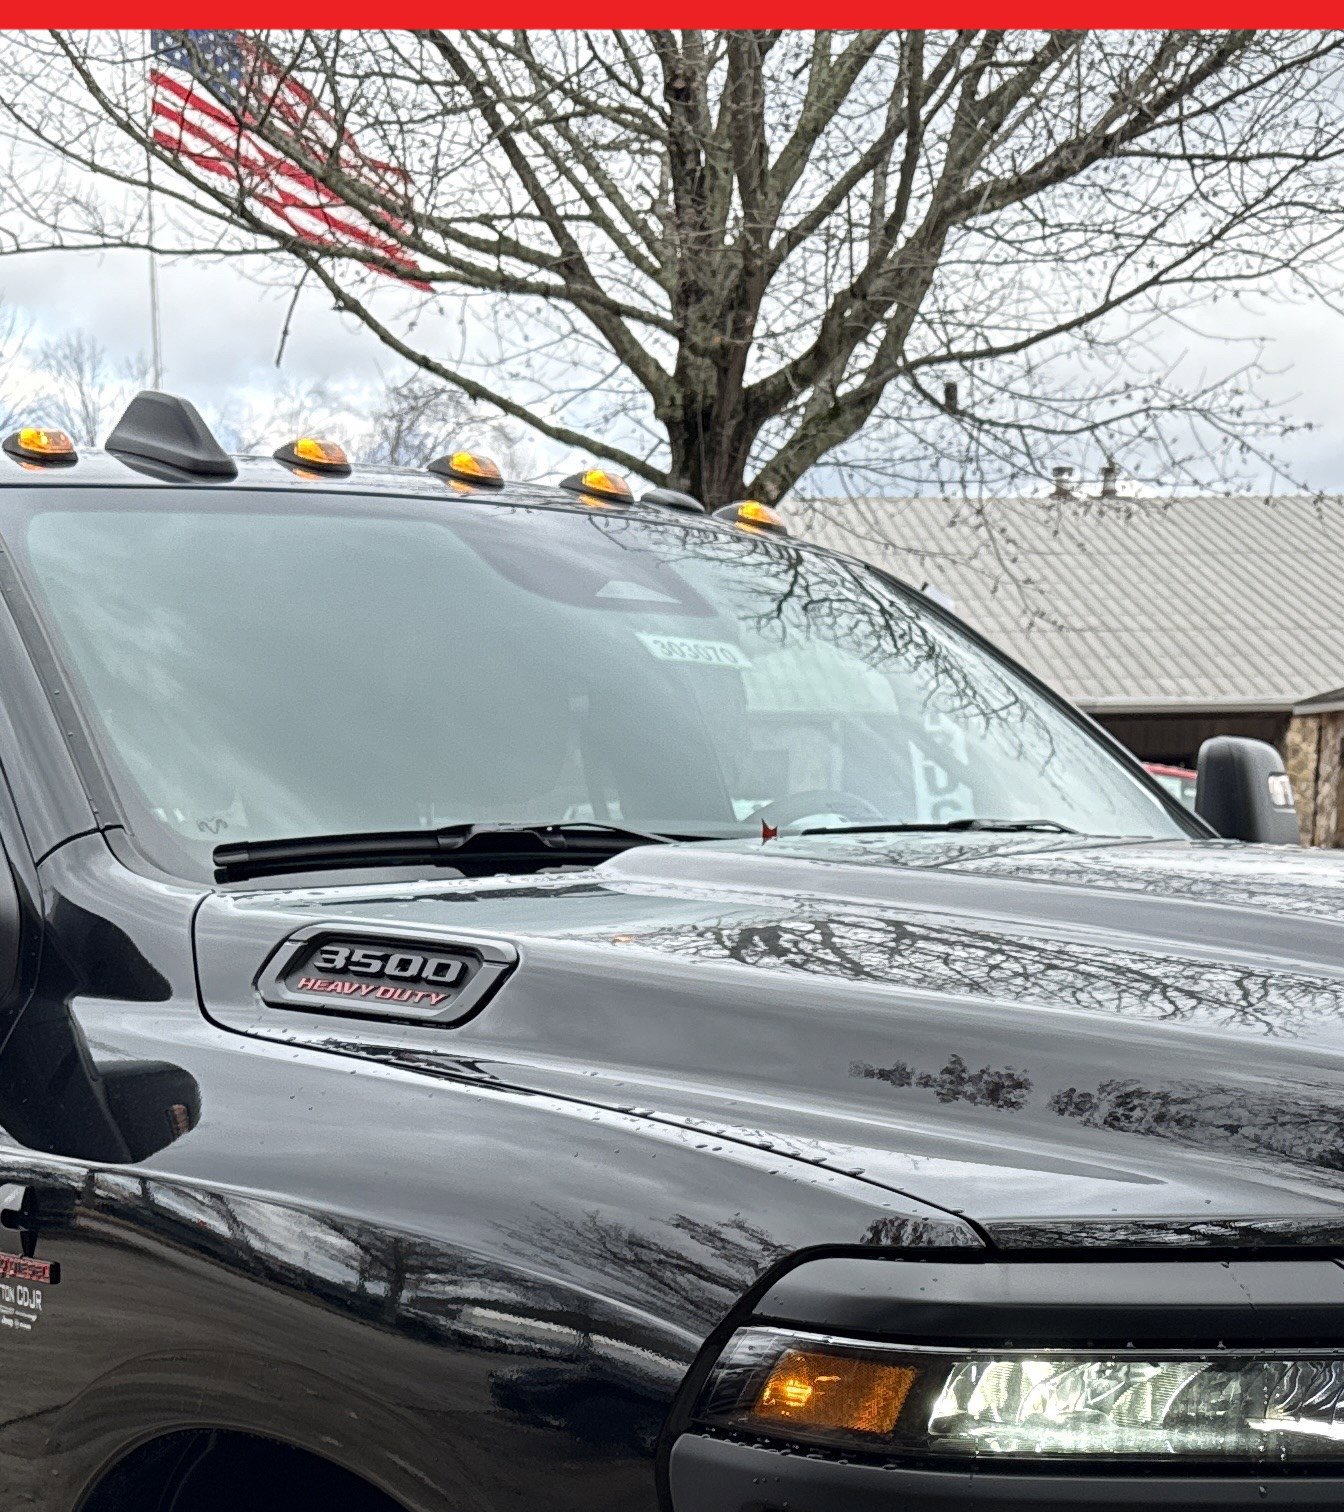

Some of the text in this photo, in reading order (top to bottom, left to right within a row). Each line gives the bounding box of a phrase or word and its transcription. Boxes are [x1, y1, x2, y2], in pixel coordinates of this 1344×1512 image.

[313, 945, 465, 985] 3500
[297, 977, 449, 1006] HEAVY DUTY
[16, 1285, 43, 1311] CDJR
